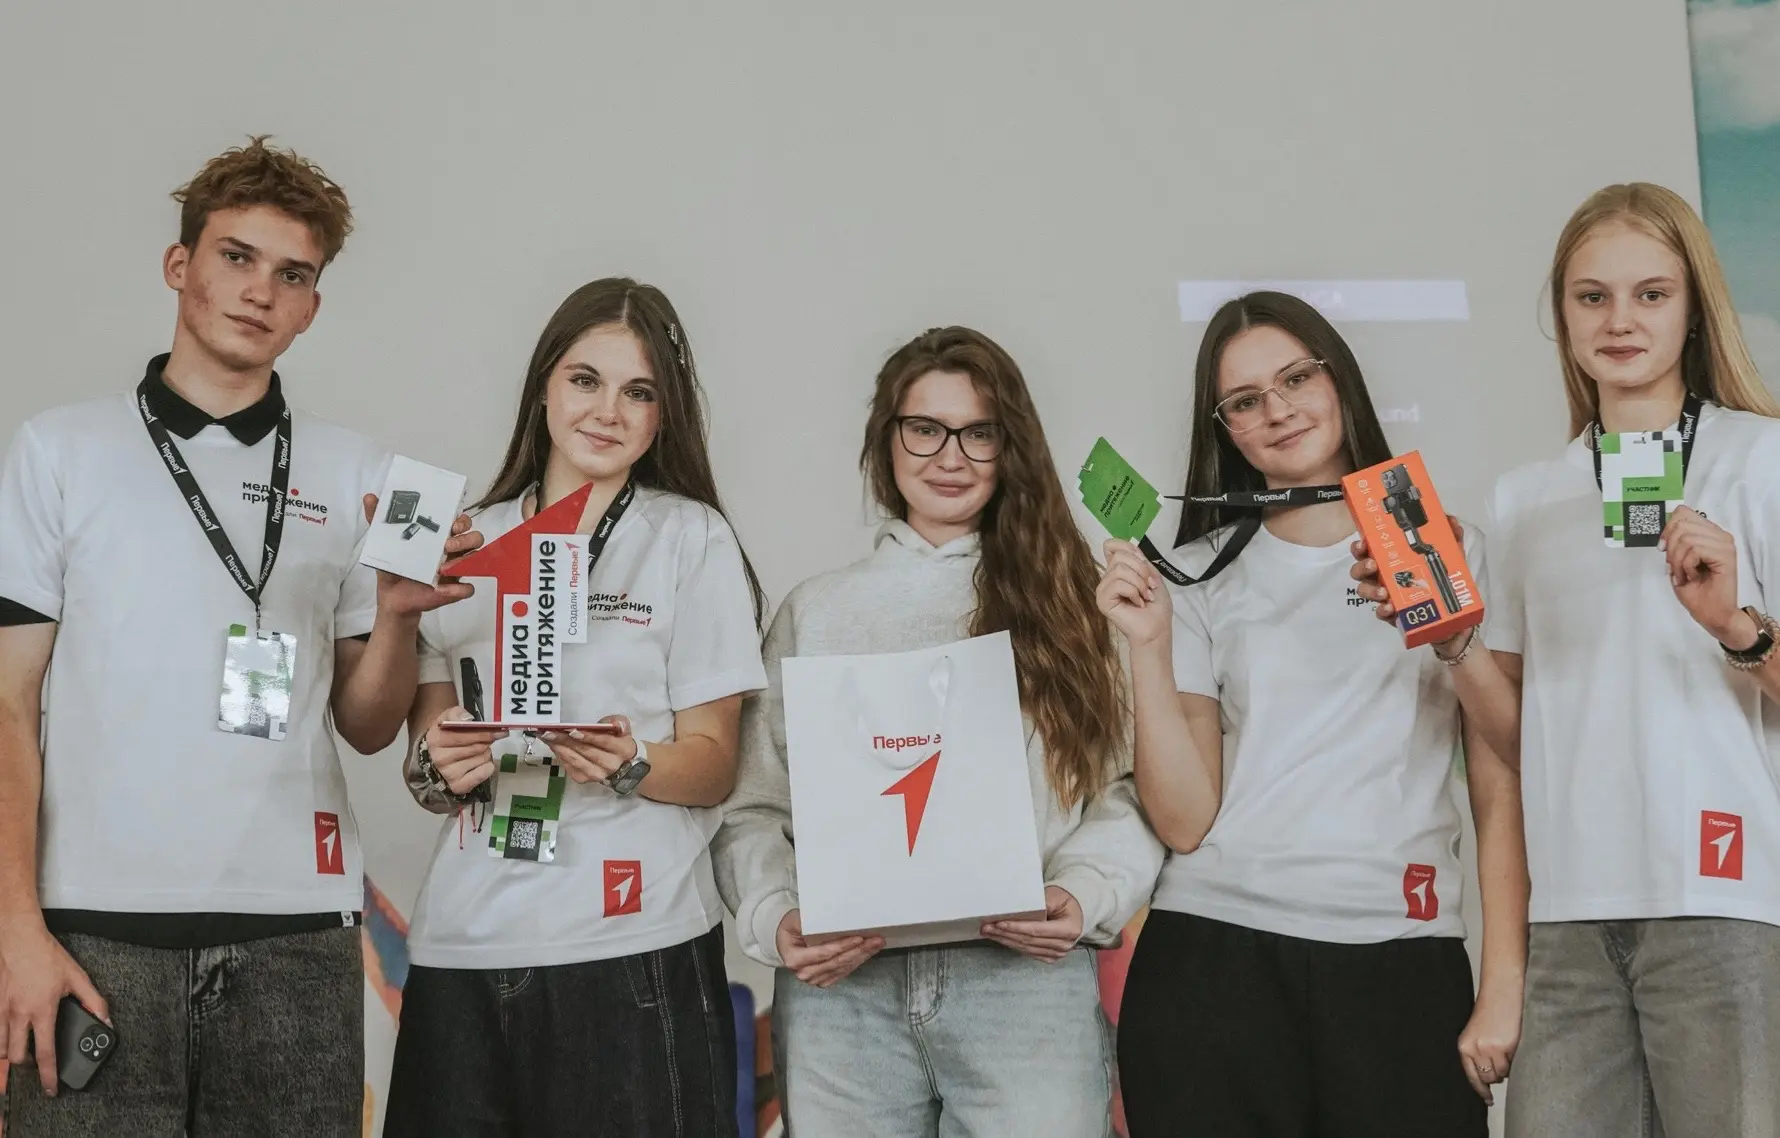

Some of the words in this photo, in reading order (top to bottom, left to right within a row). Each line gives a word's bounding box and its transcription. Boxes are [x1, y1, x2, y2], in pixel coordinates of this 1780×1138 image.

[161, 442, 181, 473] Первые
[278, 440, 290, 469] Первые
[242, 481, 271, 493] мед
[242, 492, 328, 513] прижение
[1100, 490, 1114, 512] медиа
[1104, 475, 1130, 518] притяжение
[1253, 493, 1286, 503] Первые
[190, 495, 212, 530] Первые
[271, 492, 284, 524] Первые
[225, 554, 249, 588] Первые
[569, 551, 581, 588] Первые
[1160, 561, 1187, 583] Первые
[568, 591, 579, 636] Создали
[588, 593, 618, 603] едиа
[536, 540, 559, 716] притяжение
[1405, 603, 1437, 626] Q31
[510, 624, 532, 715] медиа
